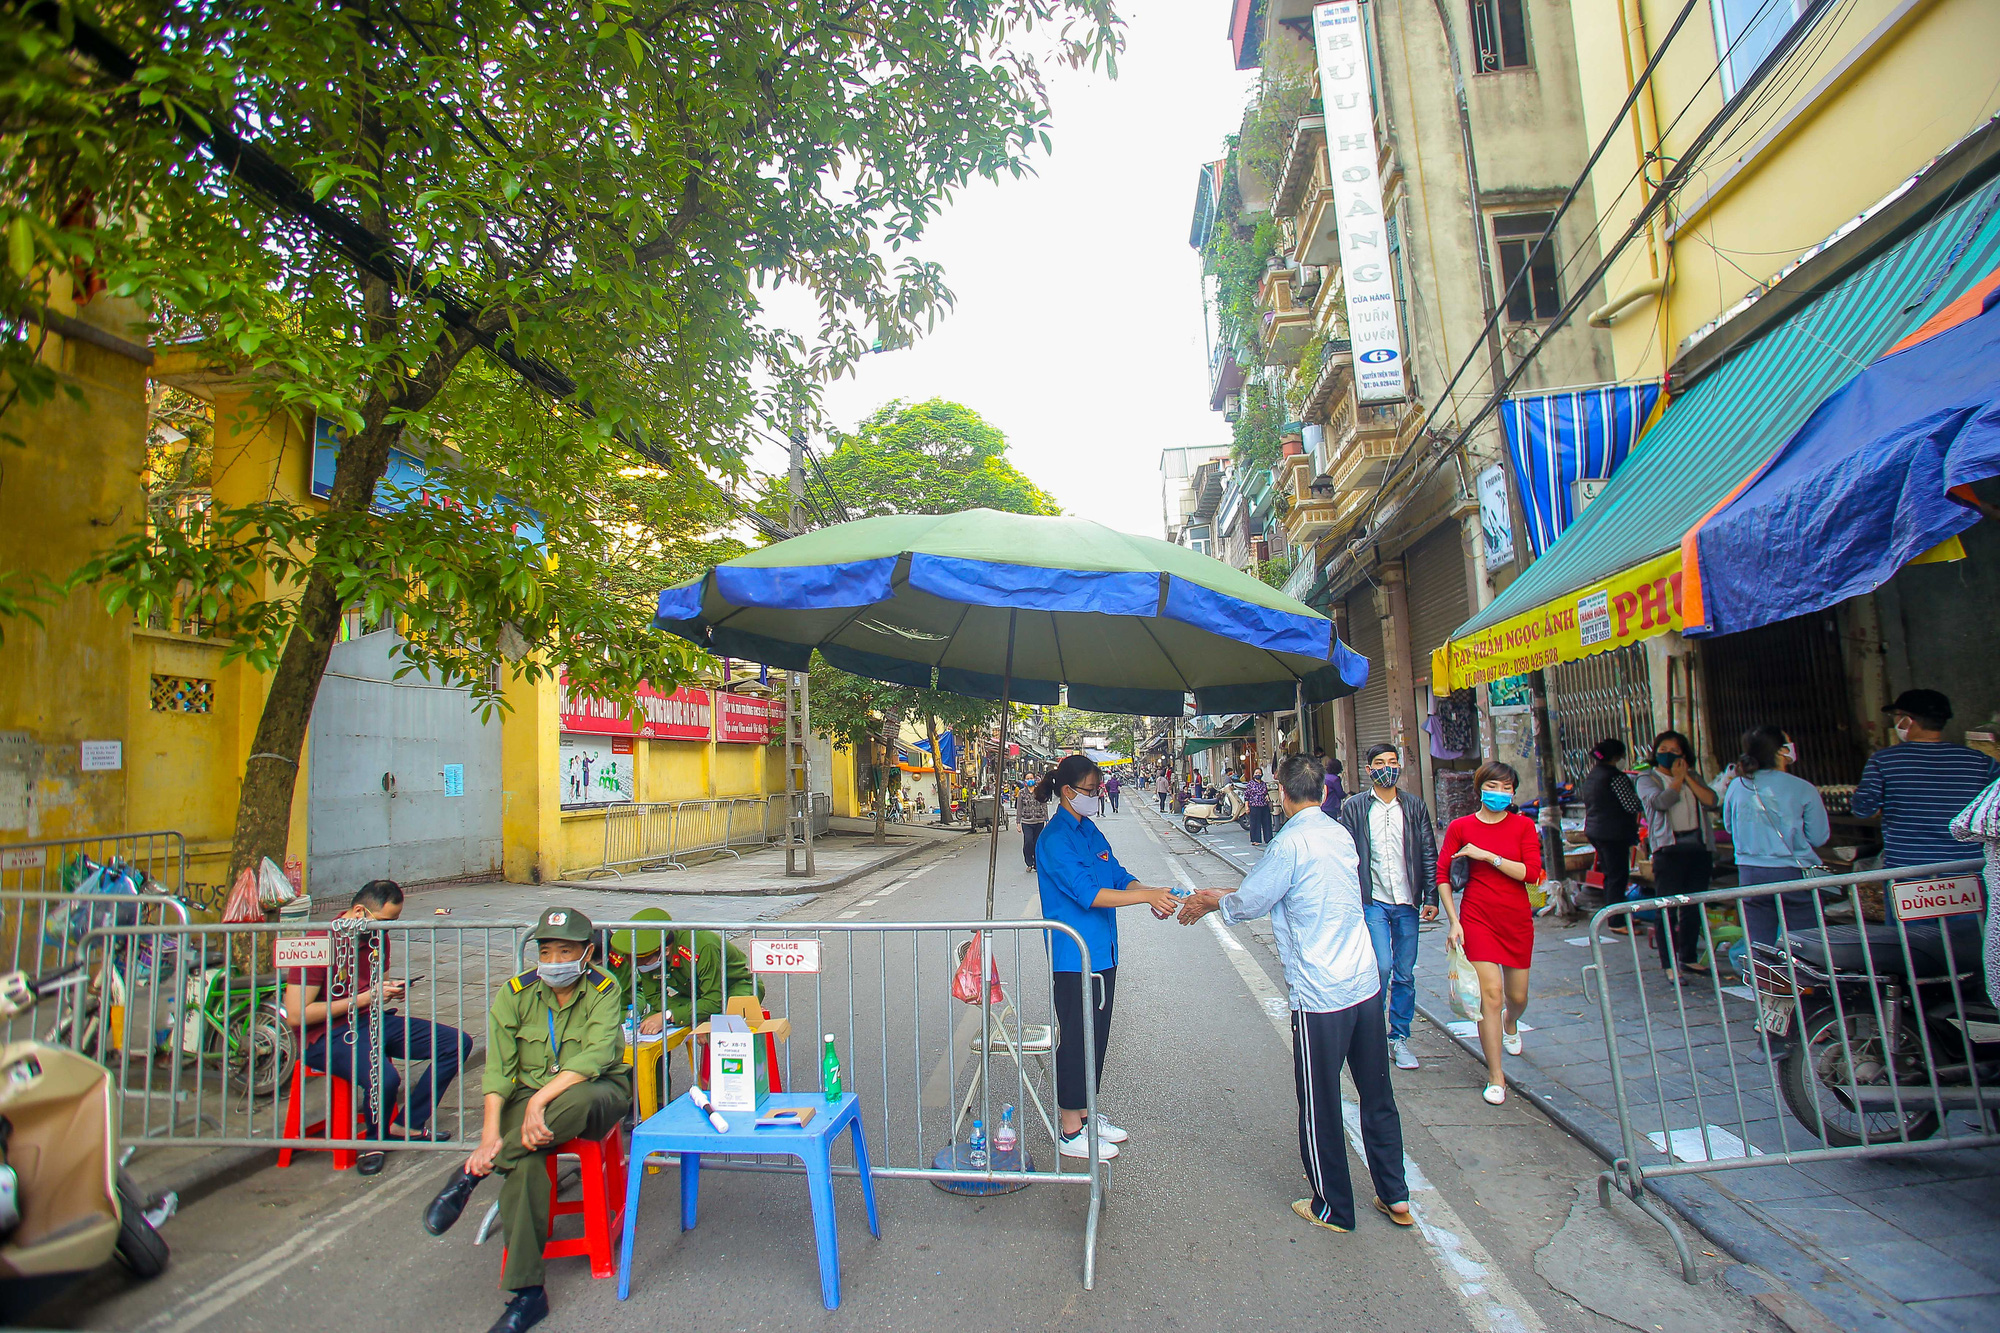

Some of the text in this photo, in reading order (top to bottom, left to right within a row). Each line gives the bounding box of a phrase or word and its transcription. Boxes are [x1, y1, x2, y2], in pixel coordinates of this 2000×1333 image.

[1338, 132, 1383, 282] HOÀNG
[1353, 293, 1391, 304] CỬA HÀNG
[1368, 350, 1389, 362] 6
[1454, 611, 1575, 670] TẠP PHẨM NGỌC ÁNH
[1514, 655, 1530, 674] 0358
[1531, 651, 1544, 670] 425
[1544, 647, 1559, 666] 528
[12, 858, 37, 866] STOP
[1917, 882, 1956, 893] C.A.H.N
[1902, 892, 1976, 910] DỪNG LẠI
[279, 948, 327, 961] DỪNG LẠI
[765, 954, 805, 966] STOP
